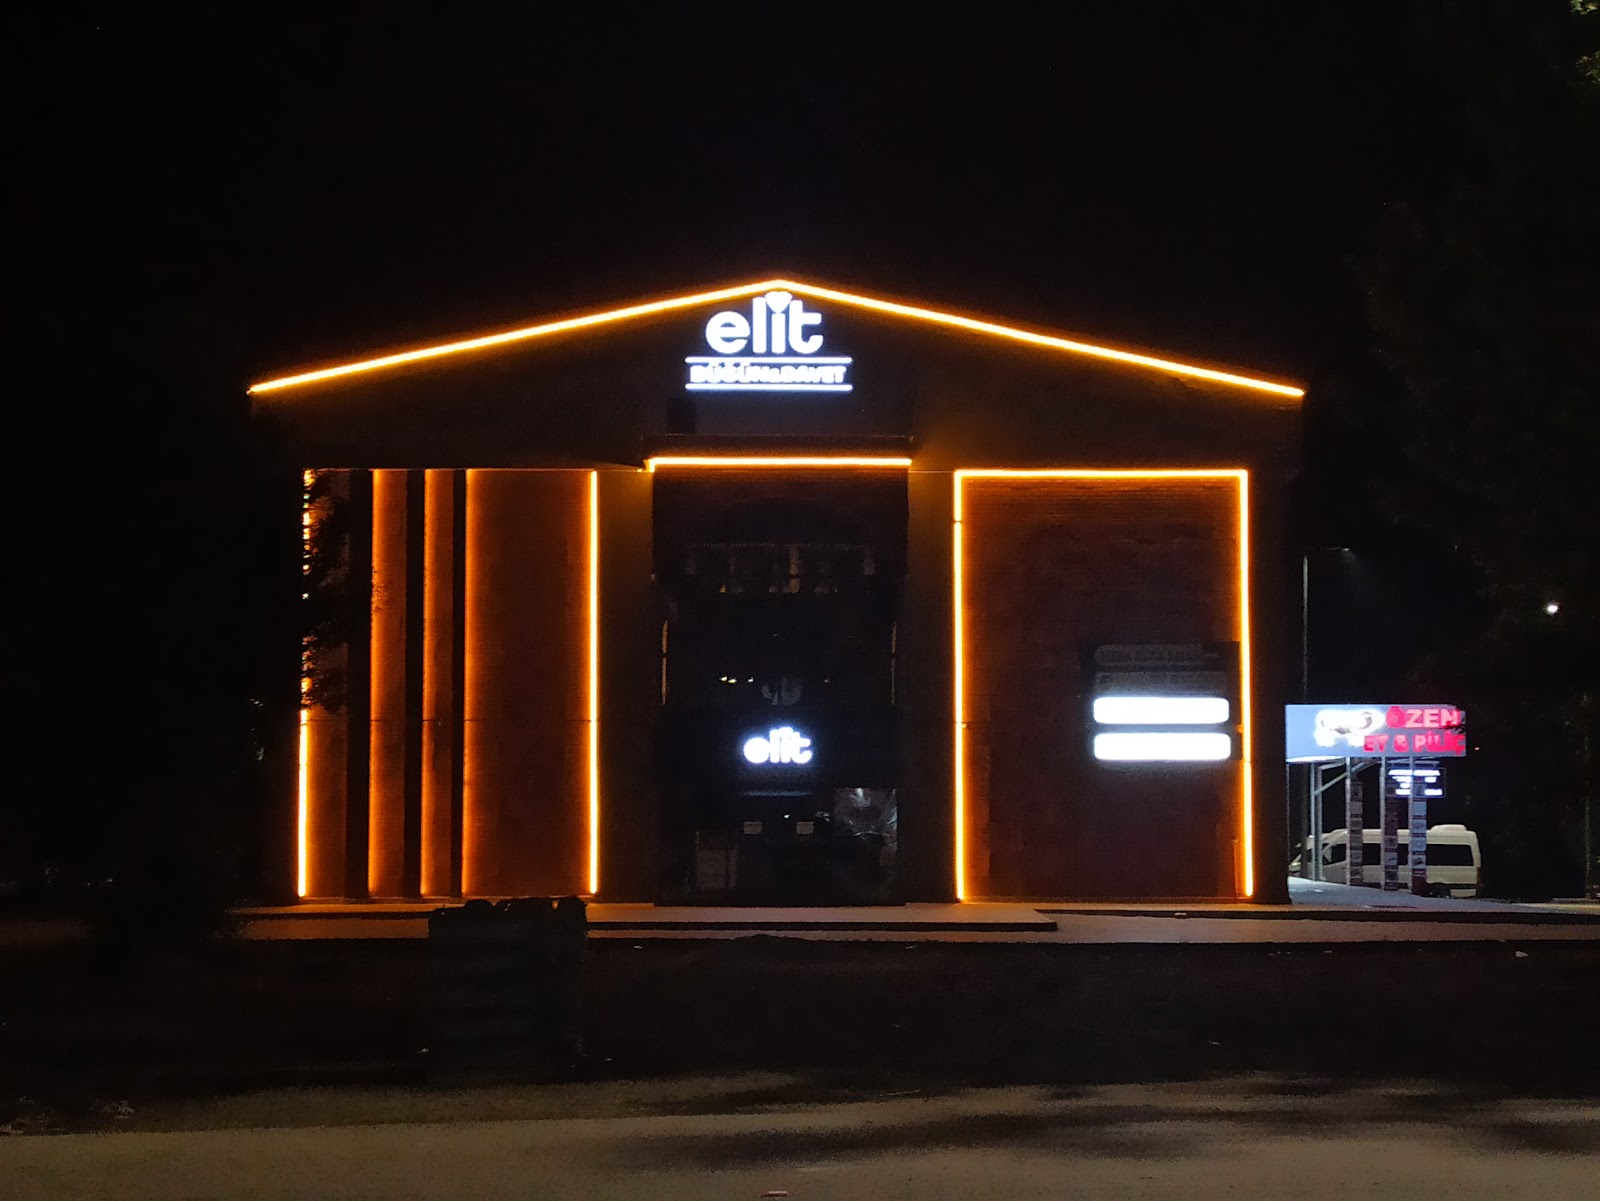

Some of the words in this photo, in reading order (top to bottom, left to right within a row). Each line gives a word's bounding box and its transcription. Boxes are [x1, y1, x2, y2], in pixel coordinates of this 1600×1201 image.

[705, 291, 824, 355] elit
[1386, 706, 1461, 729] ÖZEN
[1363, 734, 1389, 752] ET
